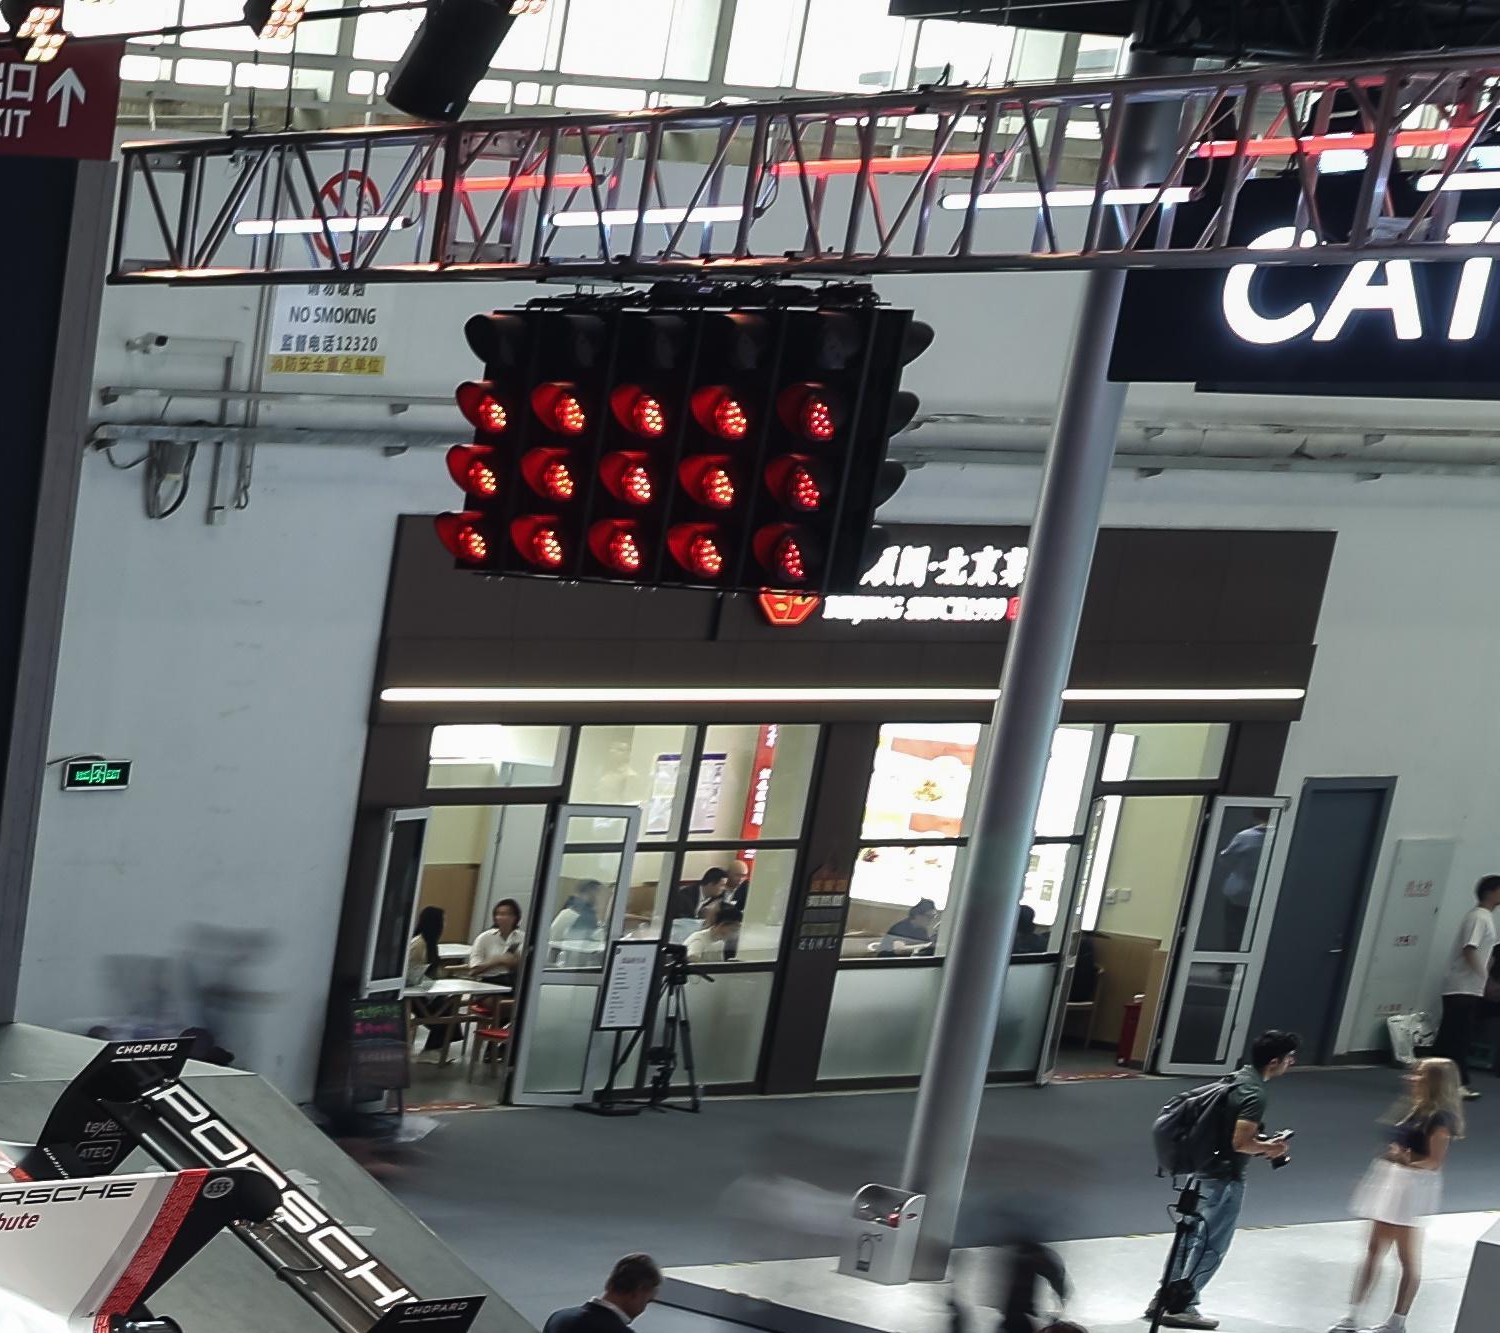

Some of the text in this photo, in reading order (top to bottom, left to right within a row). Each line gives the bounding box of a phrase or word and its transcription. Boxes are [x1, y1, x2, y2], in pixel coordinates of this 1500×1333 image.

[289, 306, 377, 324] NO SMOKING
[280, 334, 378, 353] 监督电话12320
[116, 1042, 178, 1055] CHOPARD
[79, 1146, 113, 1158] ATEC
[152, 1084, 418, 1312] PORSCH
[404, 1302, 468, 1315] CHOPARD
